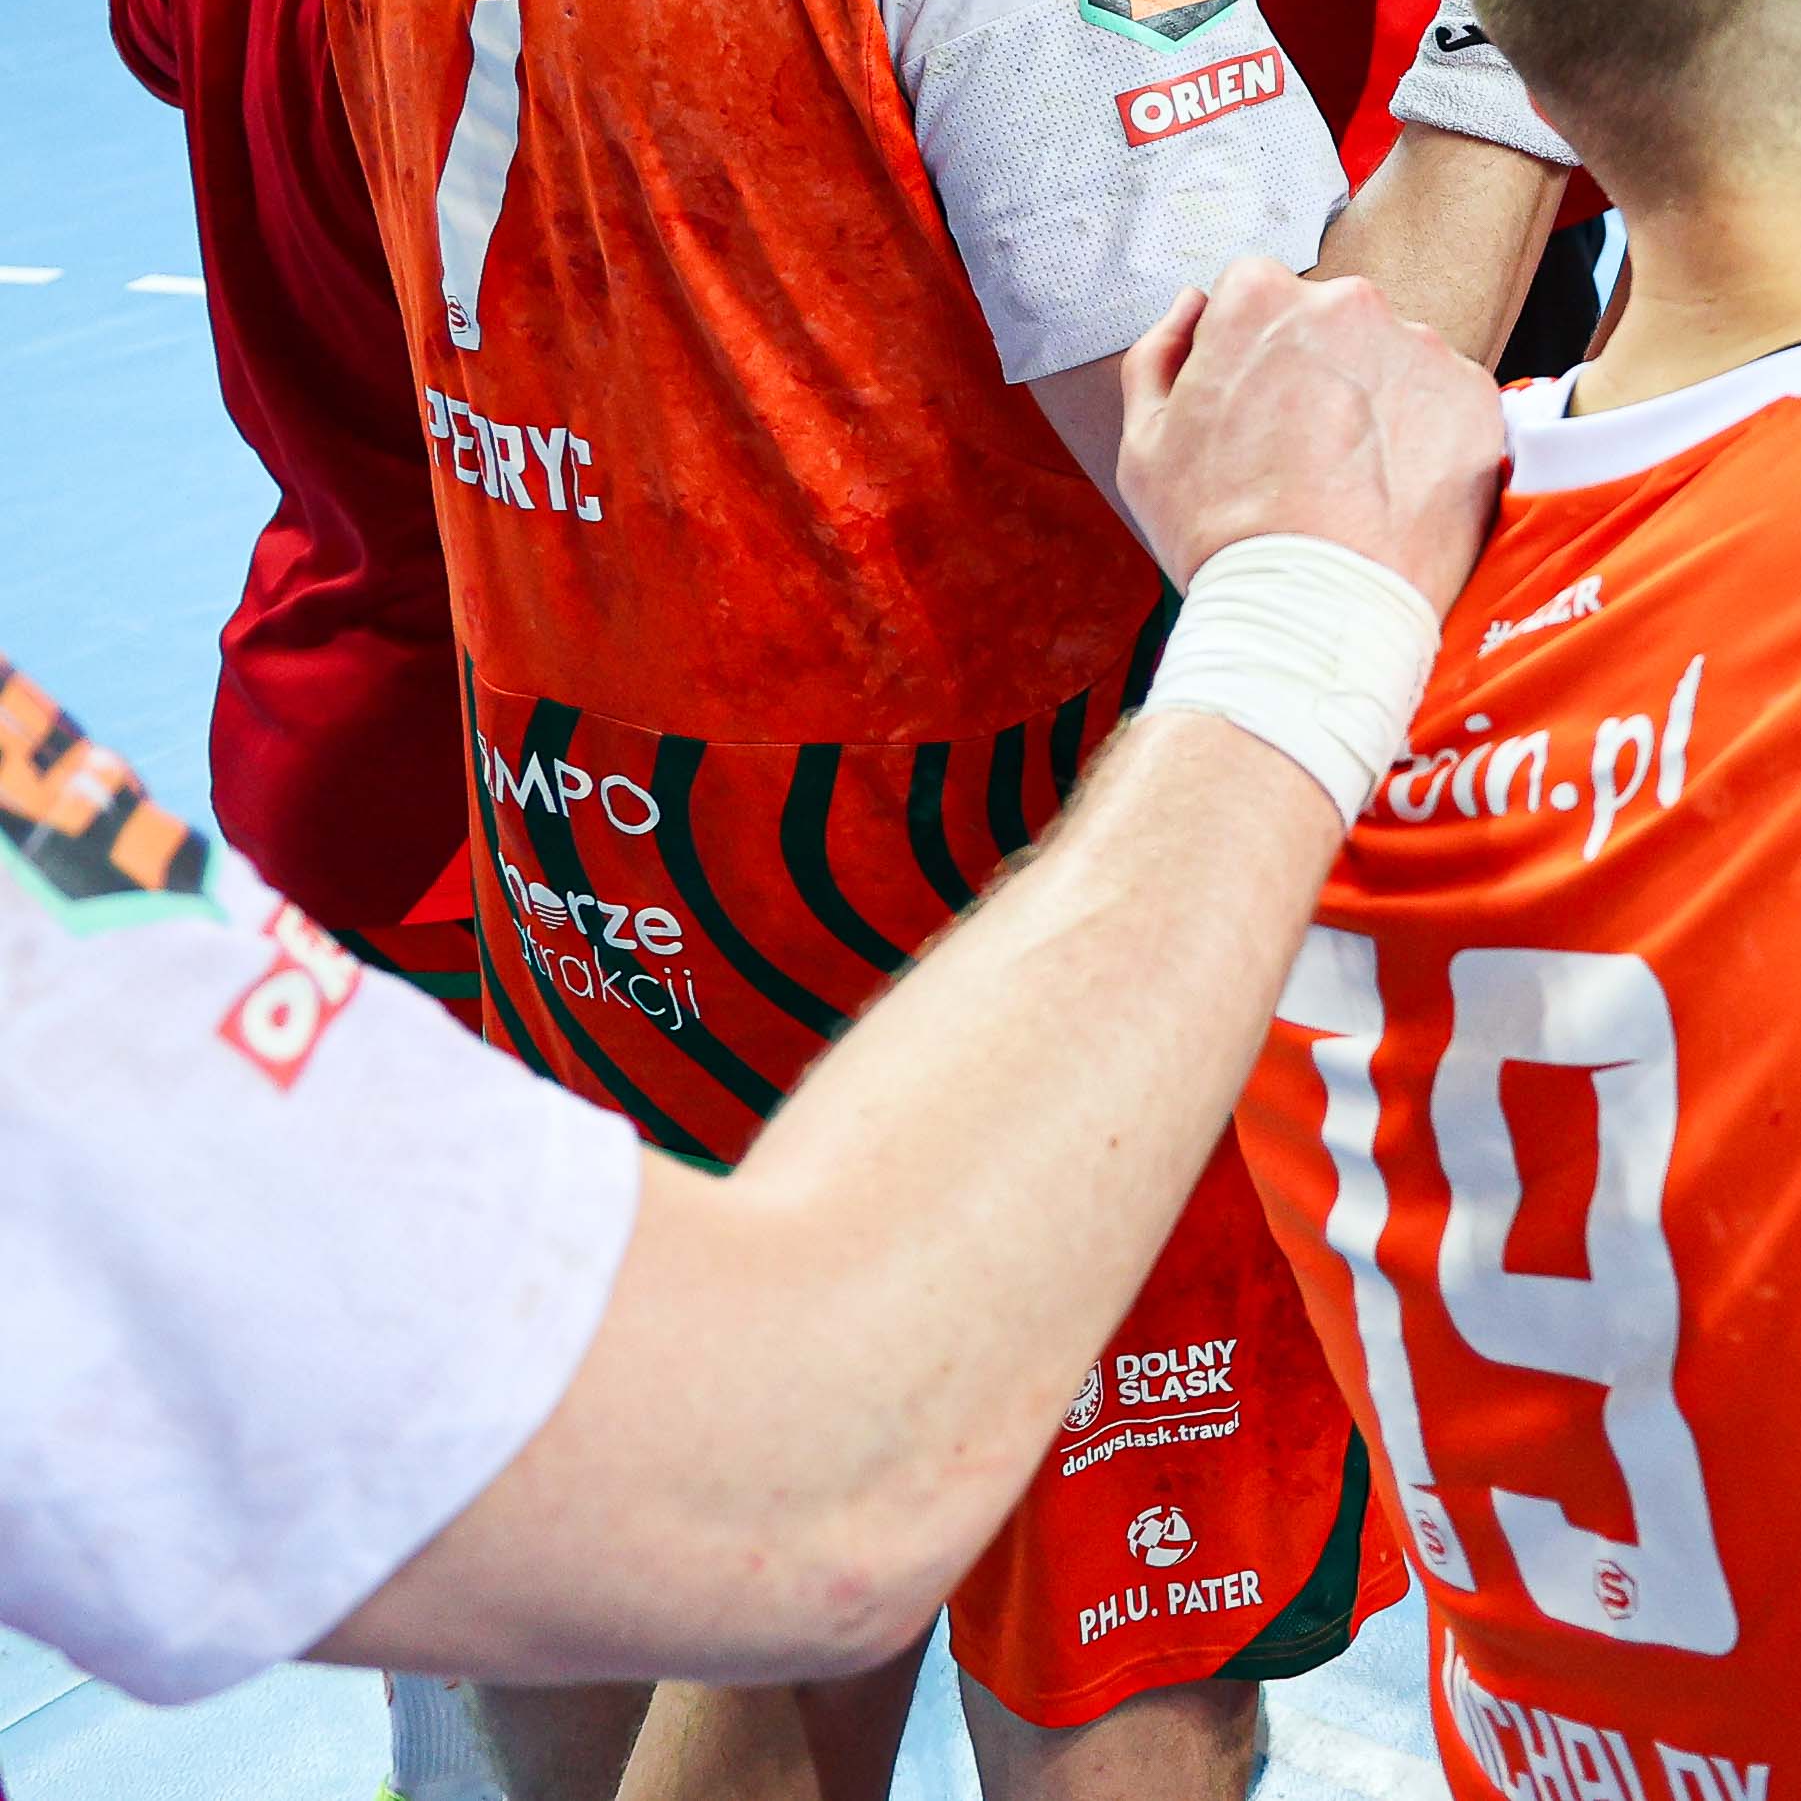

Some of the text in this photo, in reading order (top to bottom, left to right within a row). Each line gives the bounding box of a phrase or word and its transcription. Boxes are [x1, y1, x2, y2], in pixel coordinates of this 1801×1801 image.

[1129, 53, 1277, 135] ORLEN
[1274, 924, 1739, 1657] 19
[1116, 1339, 1238, 1380] DOLNY
[1118, 1366, 1234, 1406] ŚLĄSK
[1061, 1410, 1241, 1477] dolnyslask.travel
[1079, 1569, 1264, 1646] P.H.U. PATER
